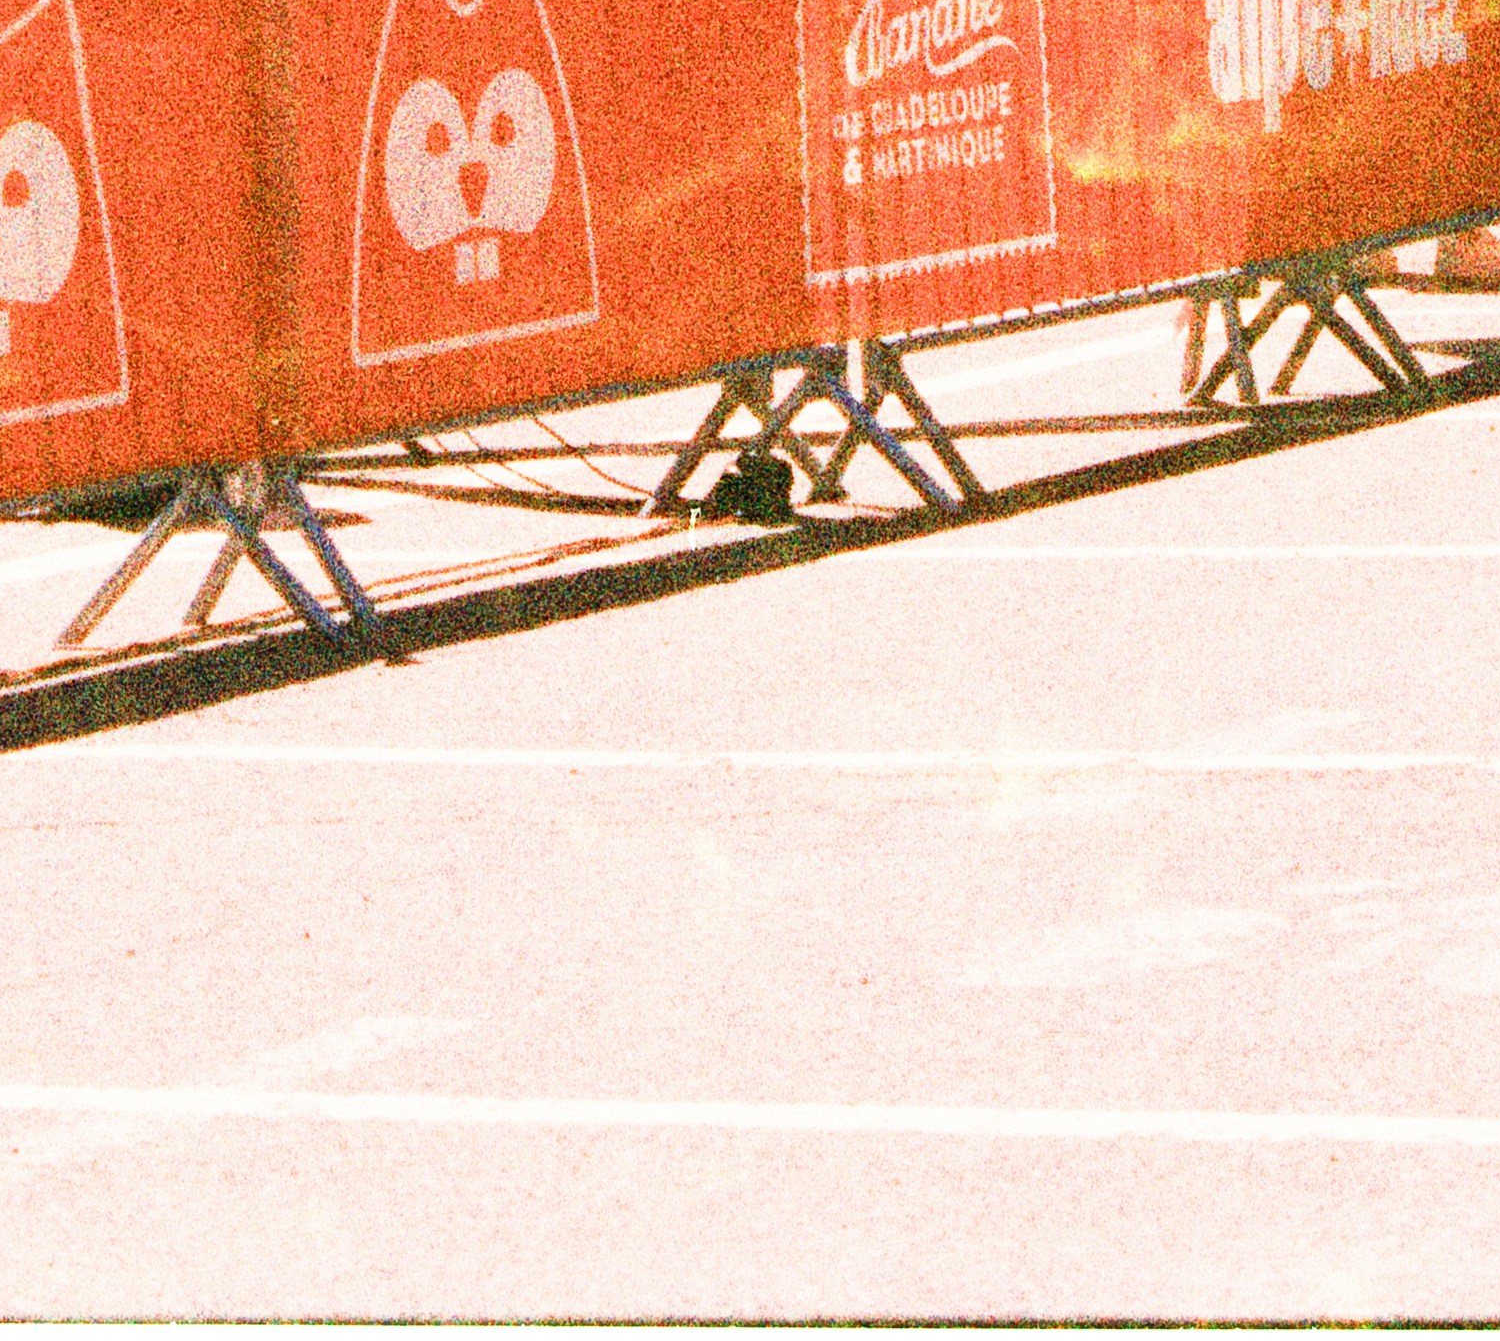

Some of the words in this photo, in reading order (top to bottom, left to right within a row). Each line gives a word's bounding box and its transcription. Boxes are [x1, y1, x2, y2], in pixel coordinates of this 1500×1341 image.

[871, 82, 1012, 135] GUADELOUPE
[843, 146, 864, 185] &
[873, 125, 1006, 180] MARTINIQUE
